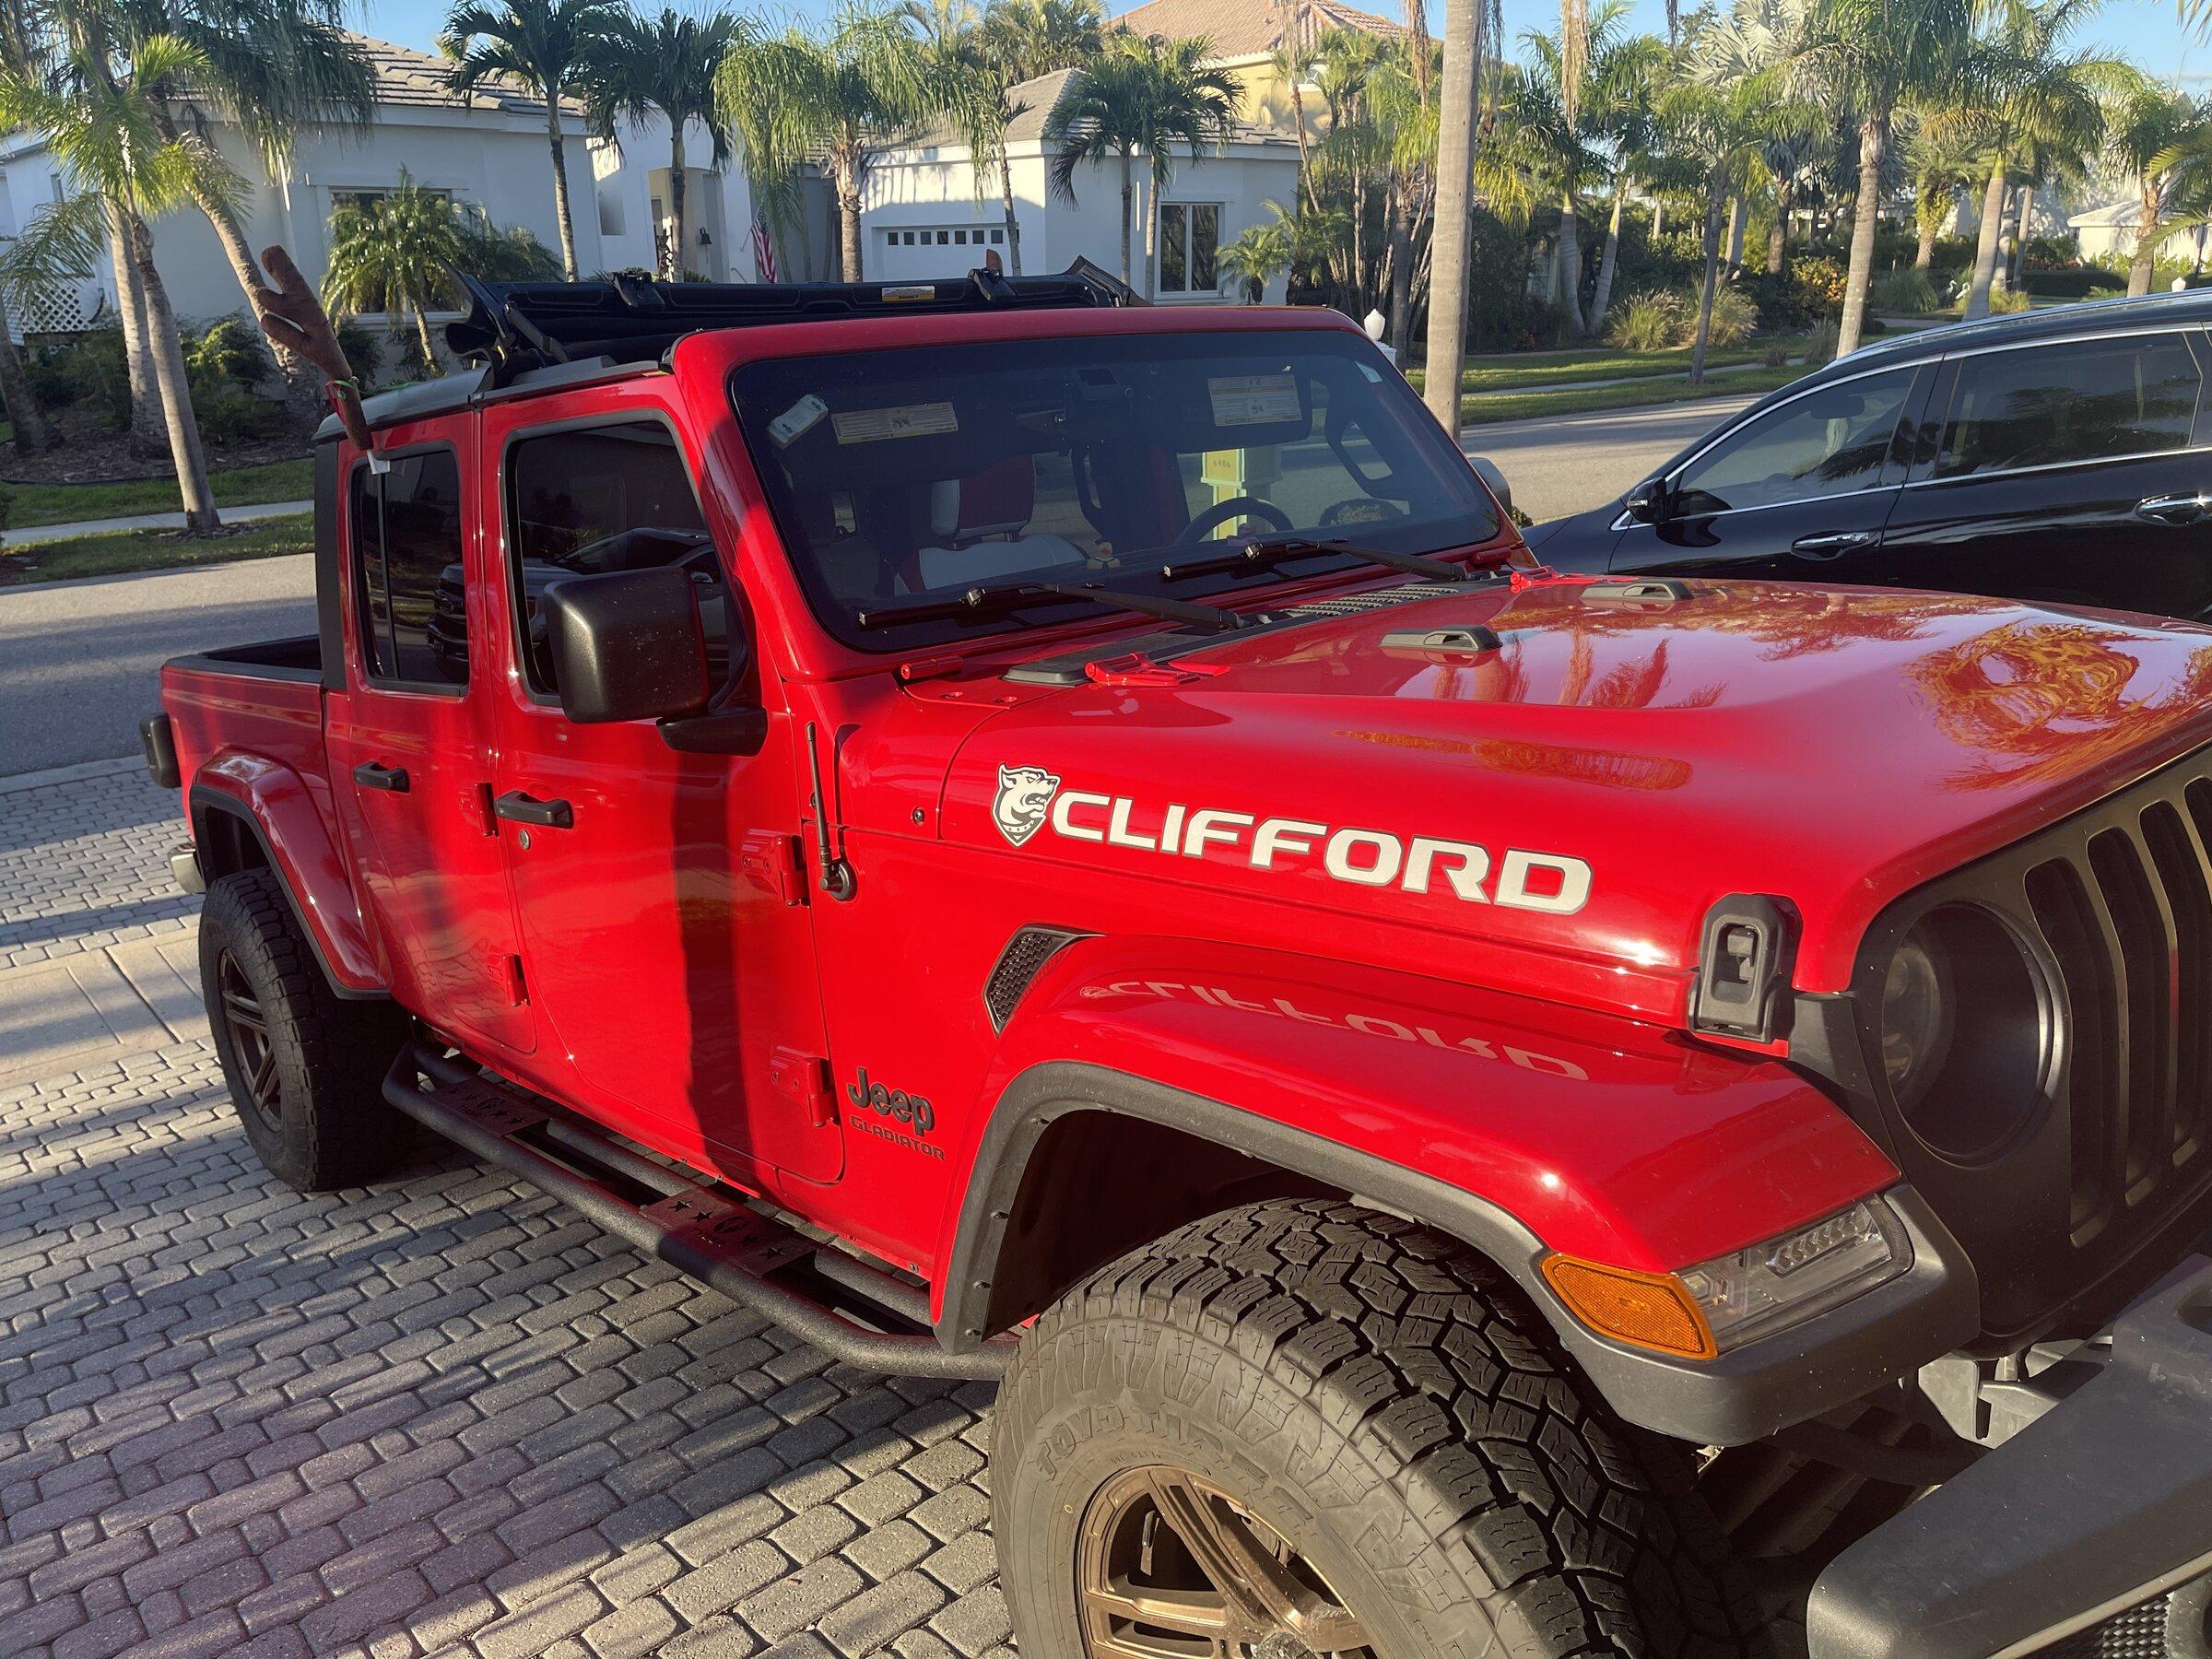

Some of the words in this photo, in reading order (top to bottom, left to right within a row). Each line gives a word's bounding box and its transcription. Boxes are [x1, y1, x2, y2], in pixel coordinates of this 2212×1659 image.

[1051, 790, 1594, 915] CLIFFORD
[847, 1066, 935, 1136] Jeep
[850, 1116, 946, 1160] GLADIATOR
